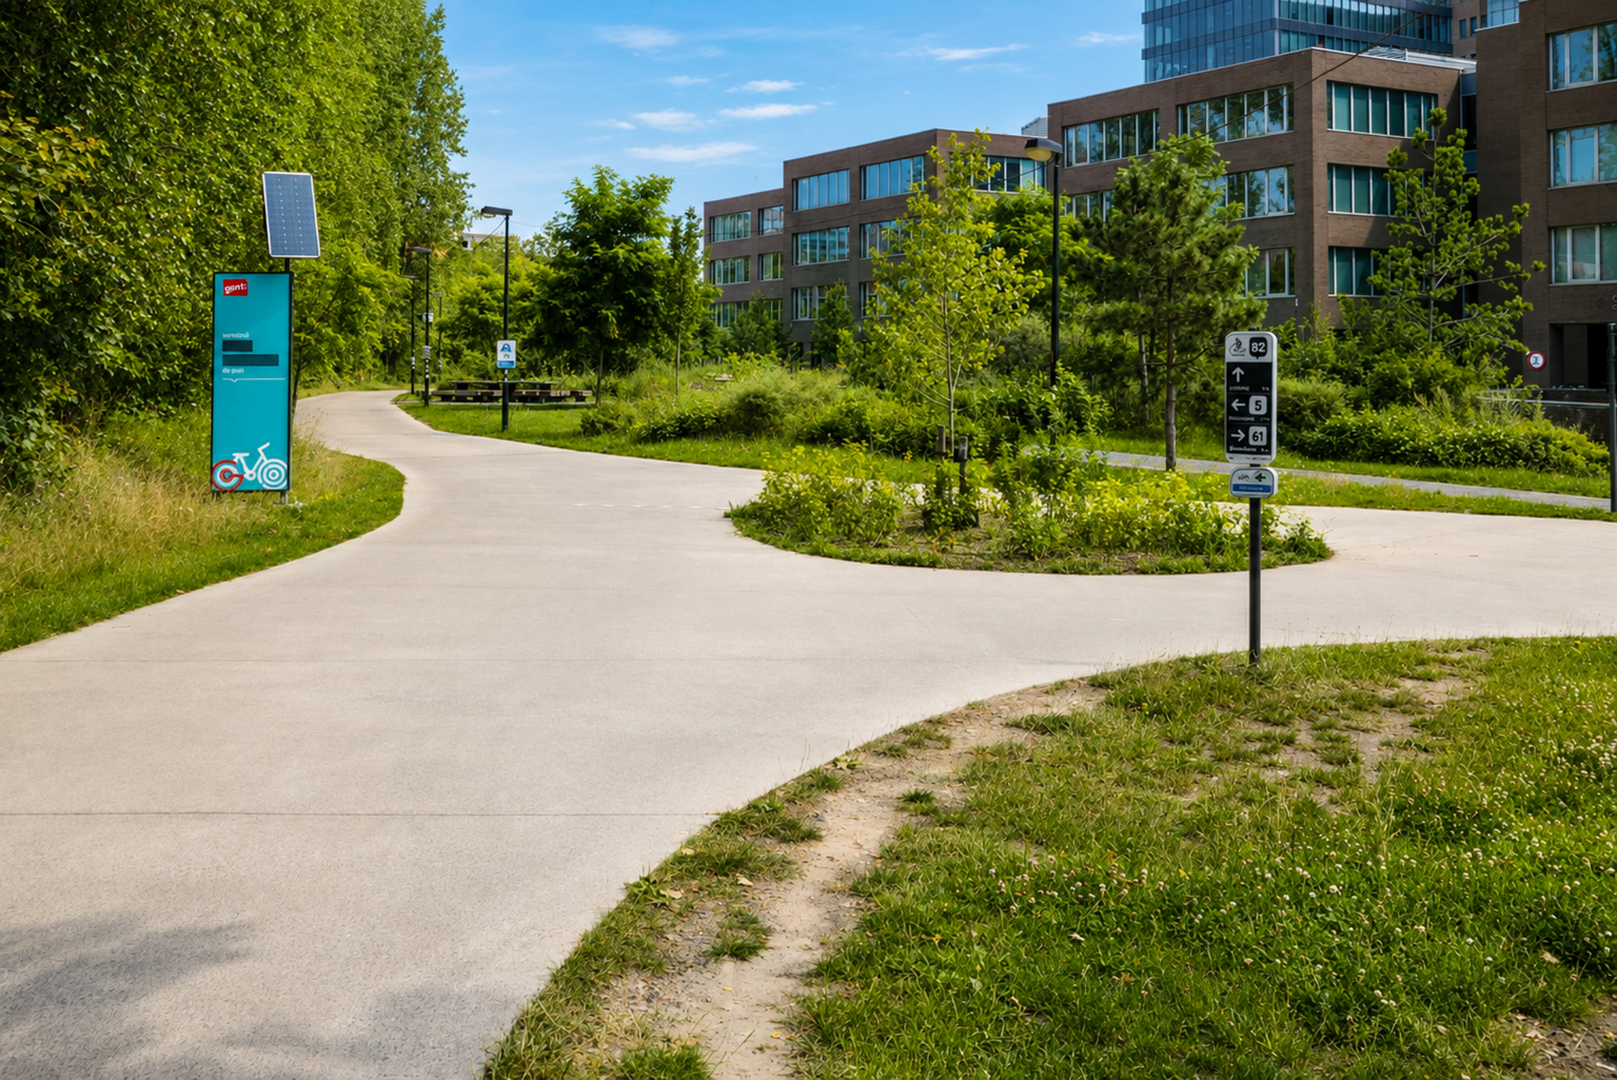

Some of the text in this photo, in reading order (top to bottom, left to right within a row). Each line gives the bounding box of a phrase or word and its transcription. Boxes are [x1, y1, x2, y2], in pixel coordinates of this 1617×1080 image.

[1251, 342, 1266, 352] 82
[1254, 400, 1262, 411] 5
[1252, 431, 1263, 442] 61
